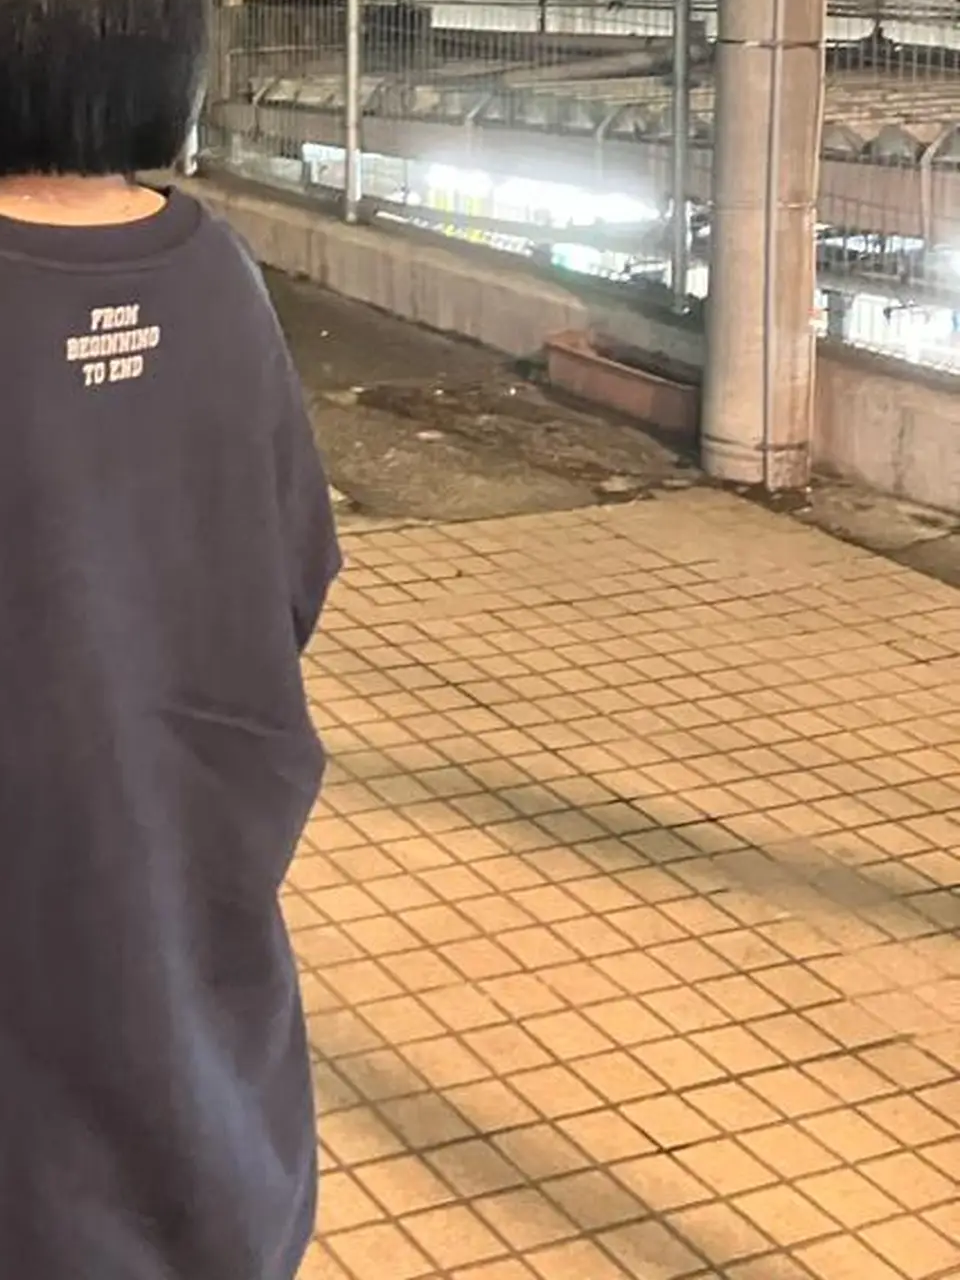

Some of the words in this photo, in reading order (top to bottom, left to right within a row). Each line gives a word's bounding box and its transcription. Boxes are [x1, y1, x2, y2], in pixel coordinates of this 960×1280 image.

[91, 304, 140, 331] FROM
[83, 361, 106, 386] TO
[108, 355, 144, 382] END
